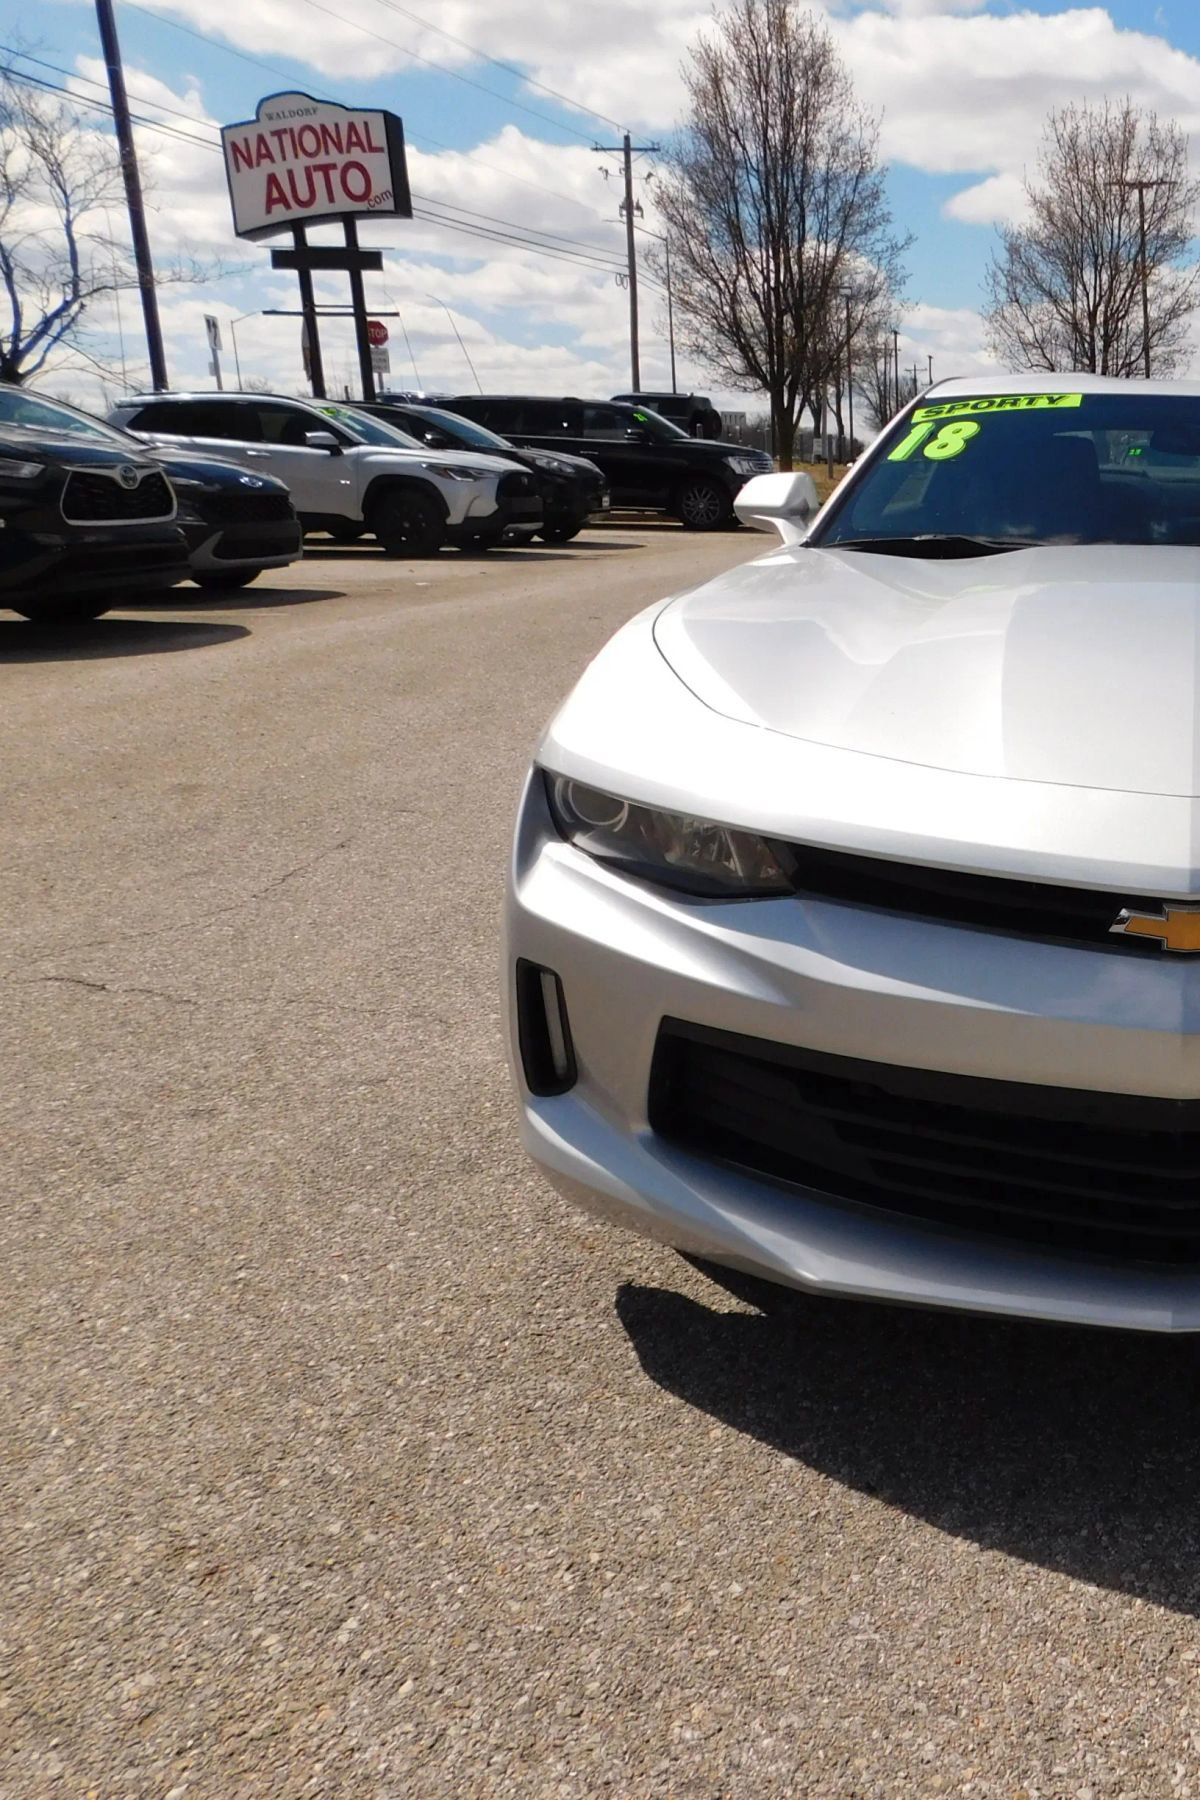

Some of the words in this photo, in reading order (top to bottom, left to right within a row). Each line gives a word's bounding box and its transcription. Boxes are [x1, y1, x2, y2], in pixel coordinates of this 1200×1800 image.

[265, 106, 319, 121] WALDORF
[230, 121, 385, 173] NATIONAL
[265, 160, 373, 215] AUTO
[920, 395, 1067, 419] SPORTY
[887, 421, 981, 461] 18
